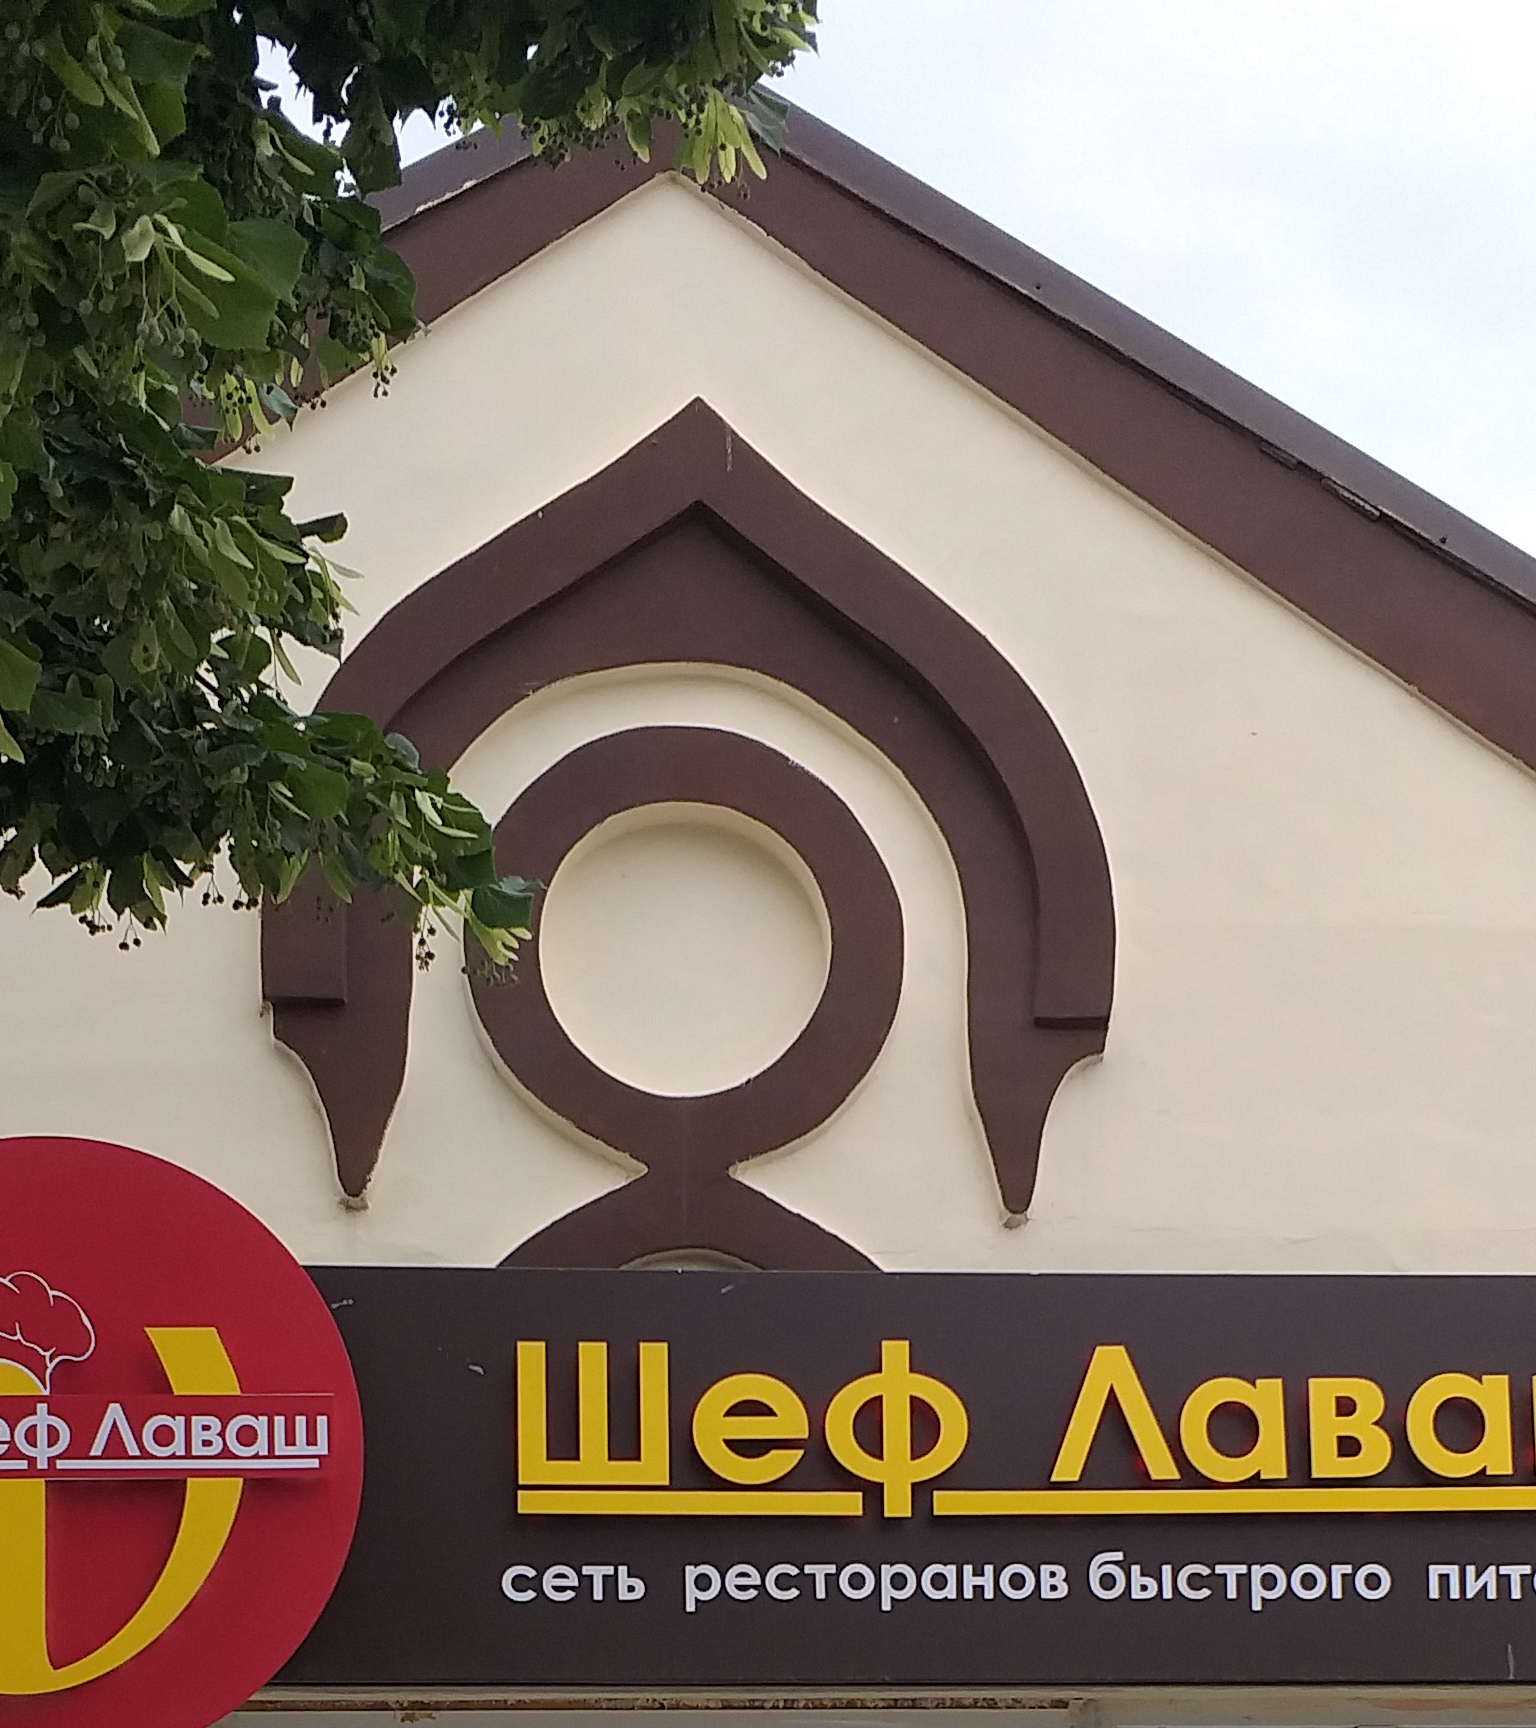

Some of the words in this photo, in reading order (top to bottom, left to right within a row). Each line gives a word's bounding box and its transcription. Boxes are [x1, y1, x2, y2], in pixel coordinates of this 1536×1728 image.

[89, 1402, 329, 1457] Лаваш
[517, 1339, 969, 1518] Шеф
[501, 1563, 646, 1602] сеть
[684, 1561, 1070, 1613] ресторанов
[1088, 1552, 1393, 1612] быстрого
